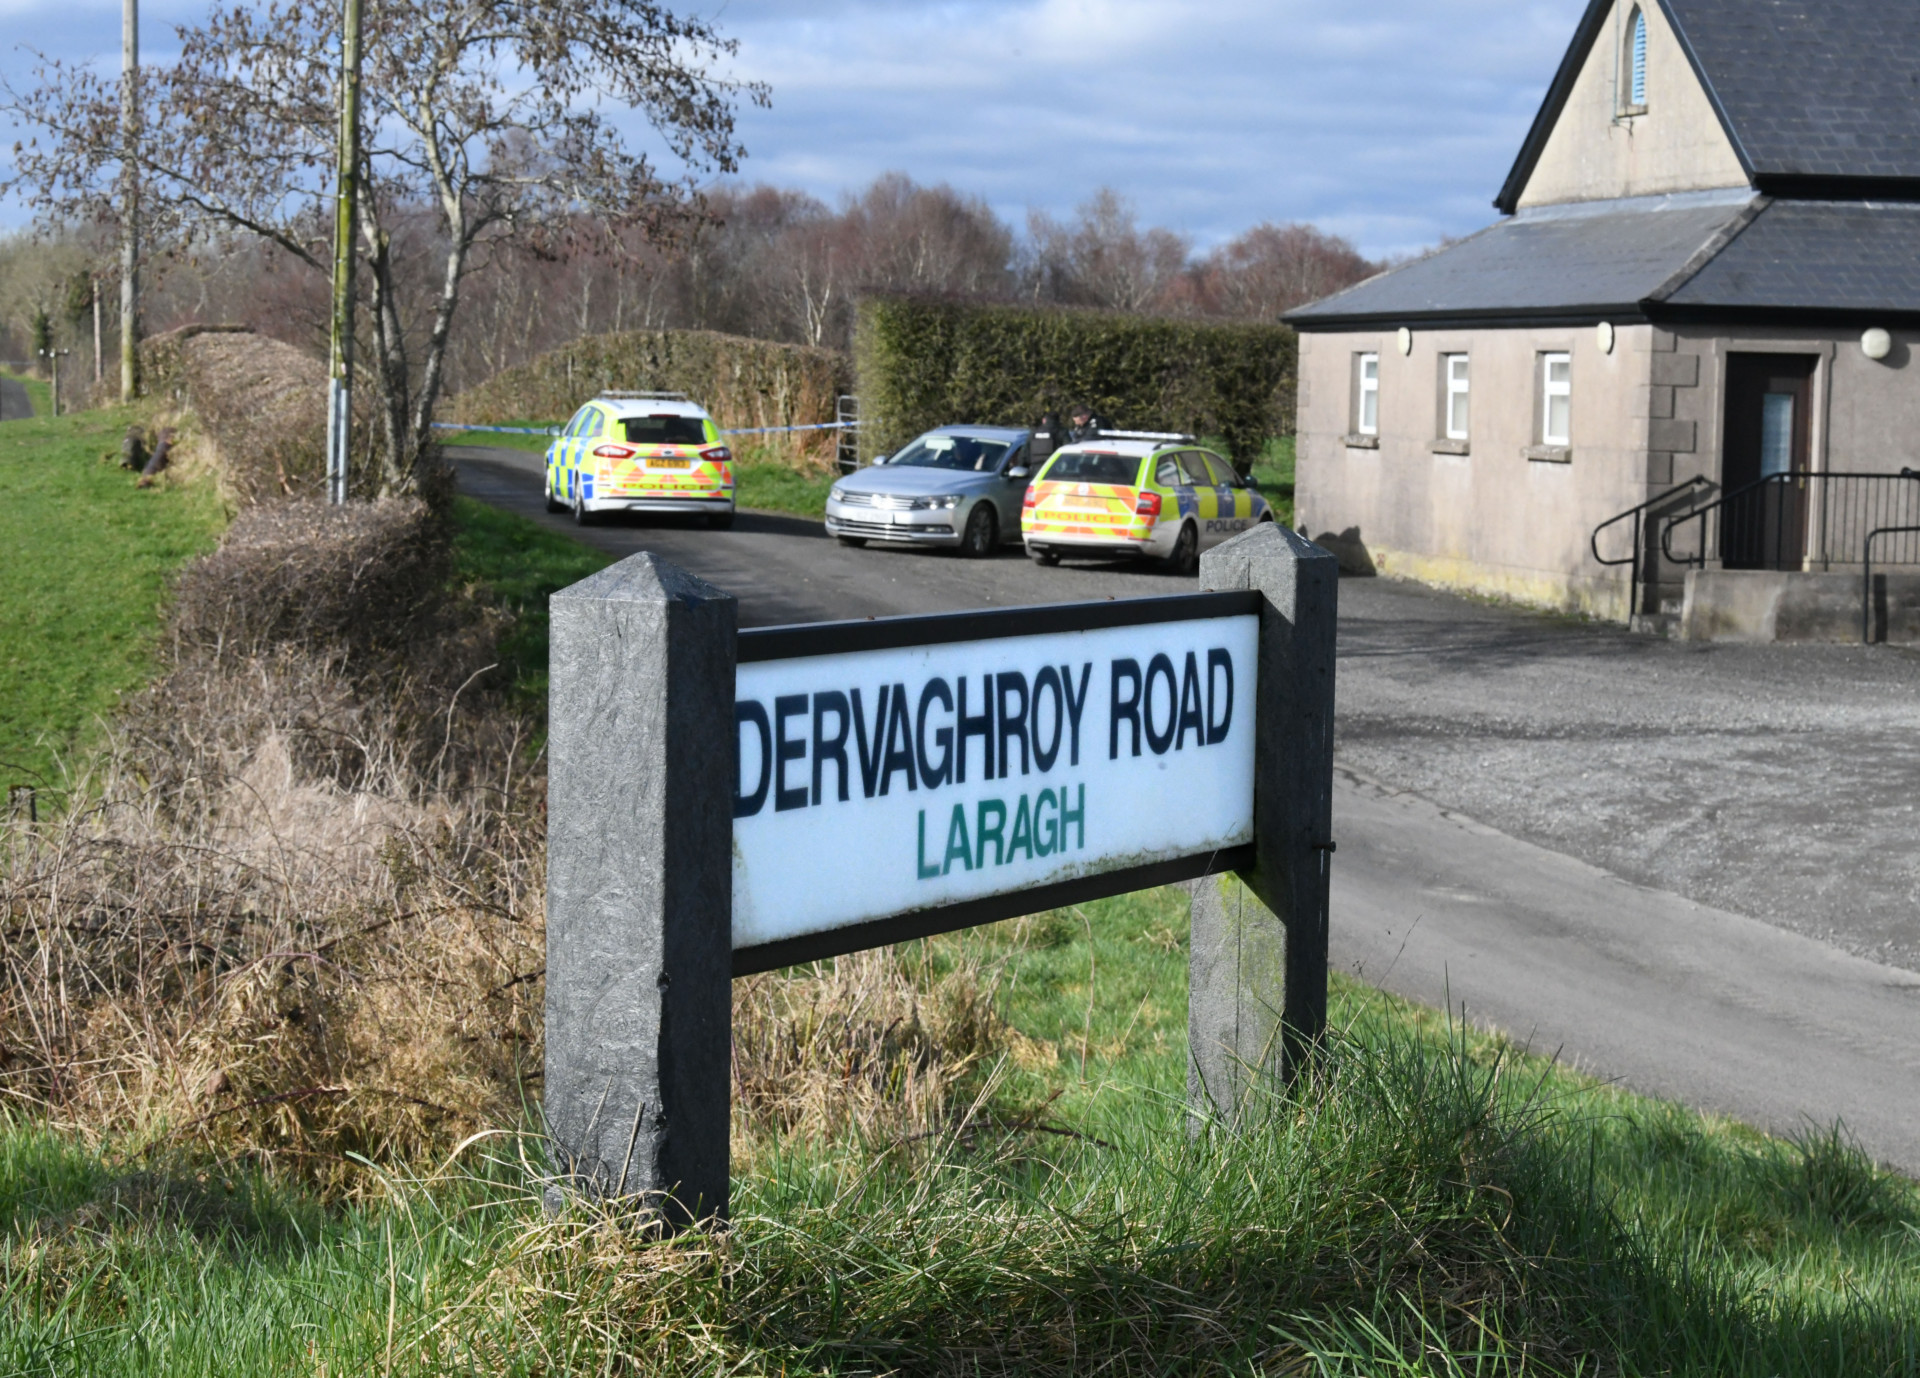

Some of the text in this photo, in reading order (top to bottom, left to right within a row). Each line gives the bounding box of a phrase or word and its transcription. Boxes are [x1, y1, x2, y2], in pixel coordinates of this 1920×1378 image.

[1044, 511, 1122, 524] POLICE
[1206, 519, 1247, 532] POLICE
[733, 647, 1235, 819] DERVAGHROY ROAD
[916, 782, 1086, 880] LARAGH
